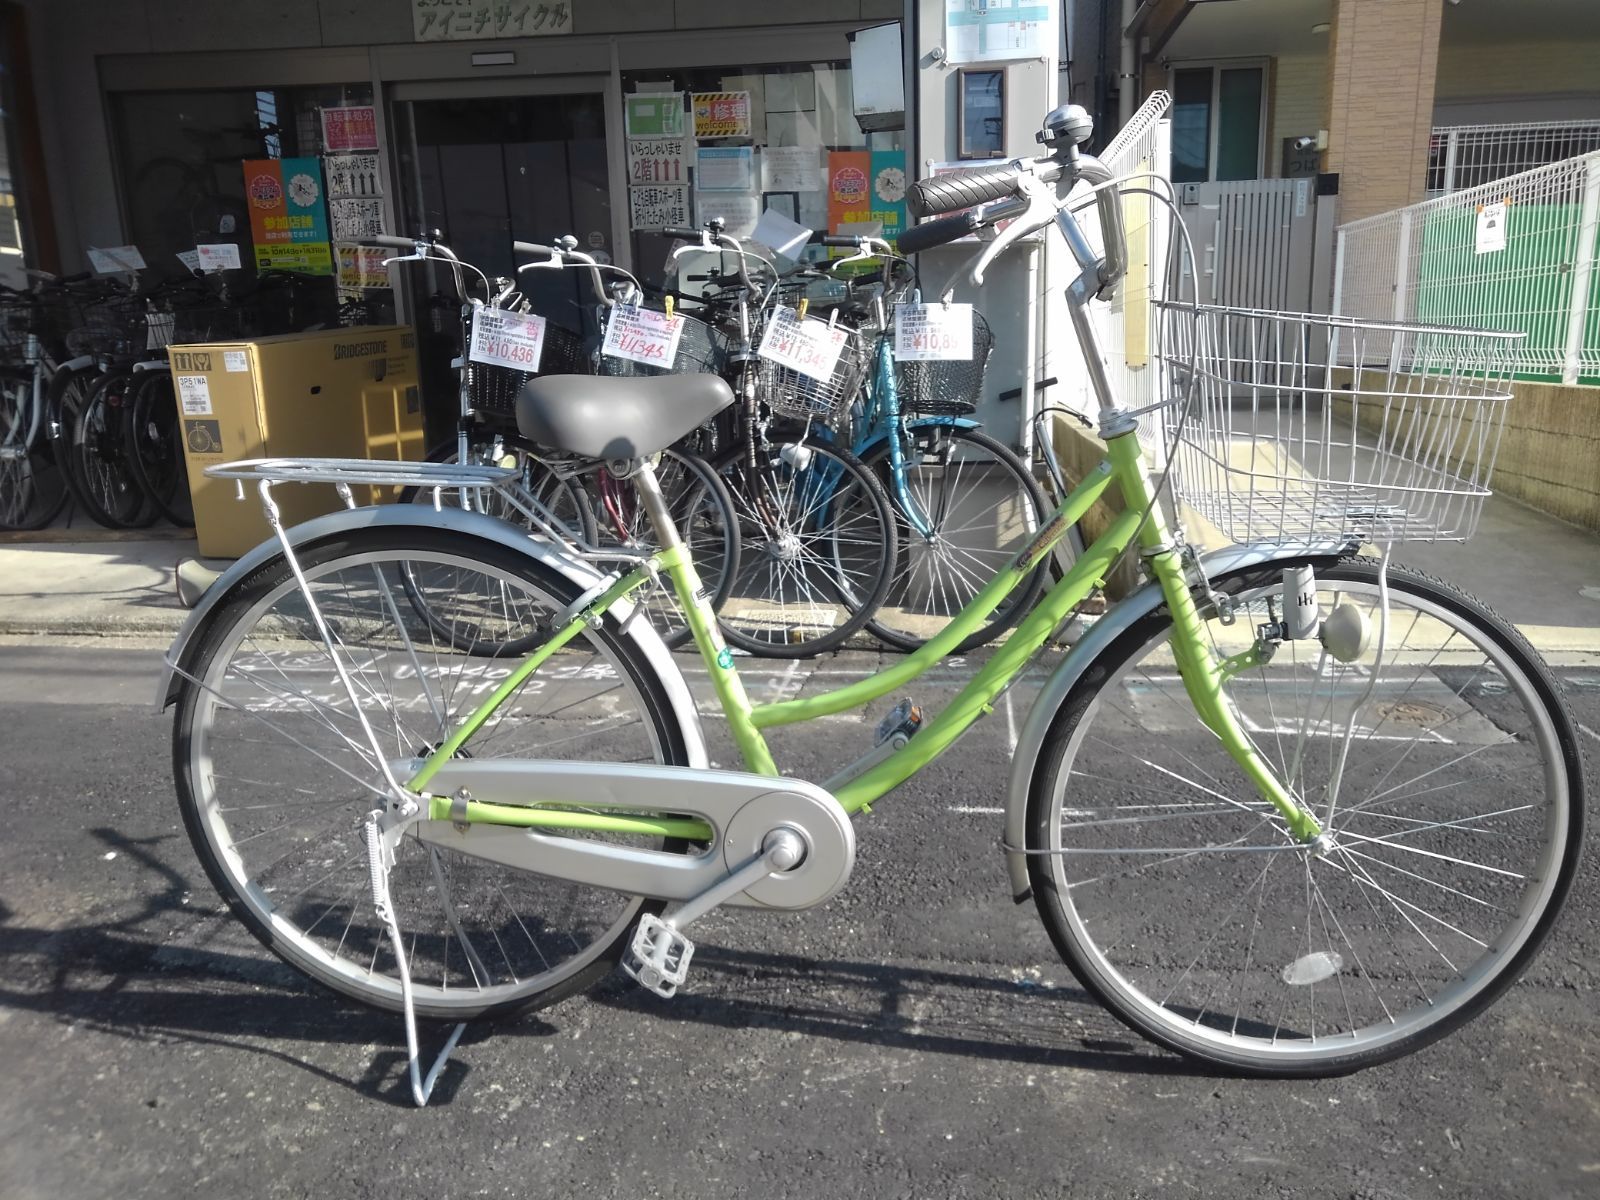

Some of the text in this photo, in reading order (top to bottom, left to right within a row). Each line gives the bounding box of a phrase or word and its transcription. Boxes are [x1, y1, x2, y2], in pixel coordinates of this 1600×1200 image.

[419, 3, 568, 36] アイニチサイクル
[714, 103, 747, 120] 修理
[630, 141, 682, 156] いらっしゃいませ
[327, 157, 376, 171] いらっしゃいませ
[334, 340, 387, 360] BRIDGESTONE
[487, 342, 535, 363] ¥10,436
[180, 377, 207, 386] 3P51WA
